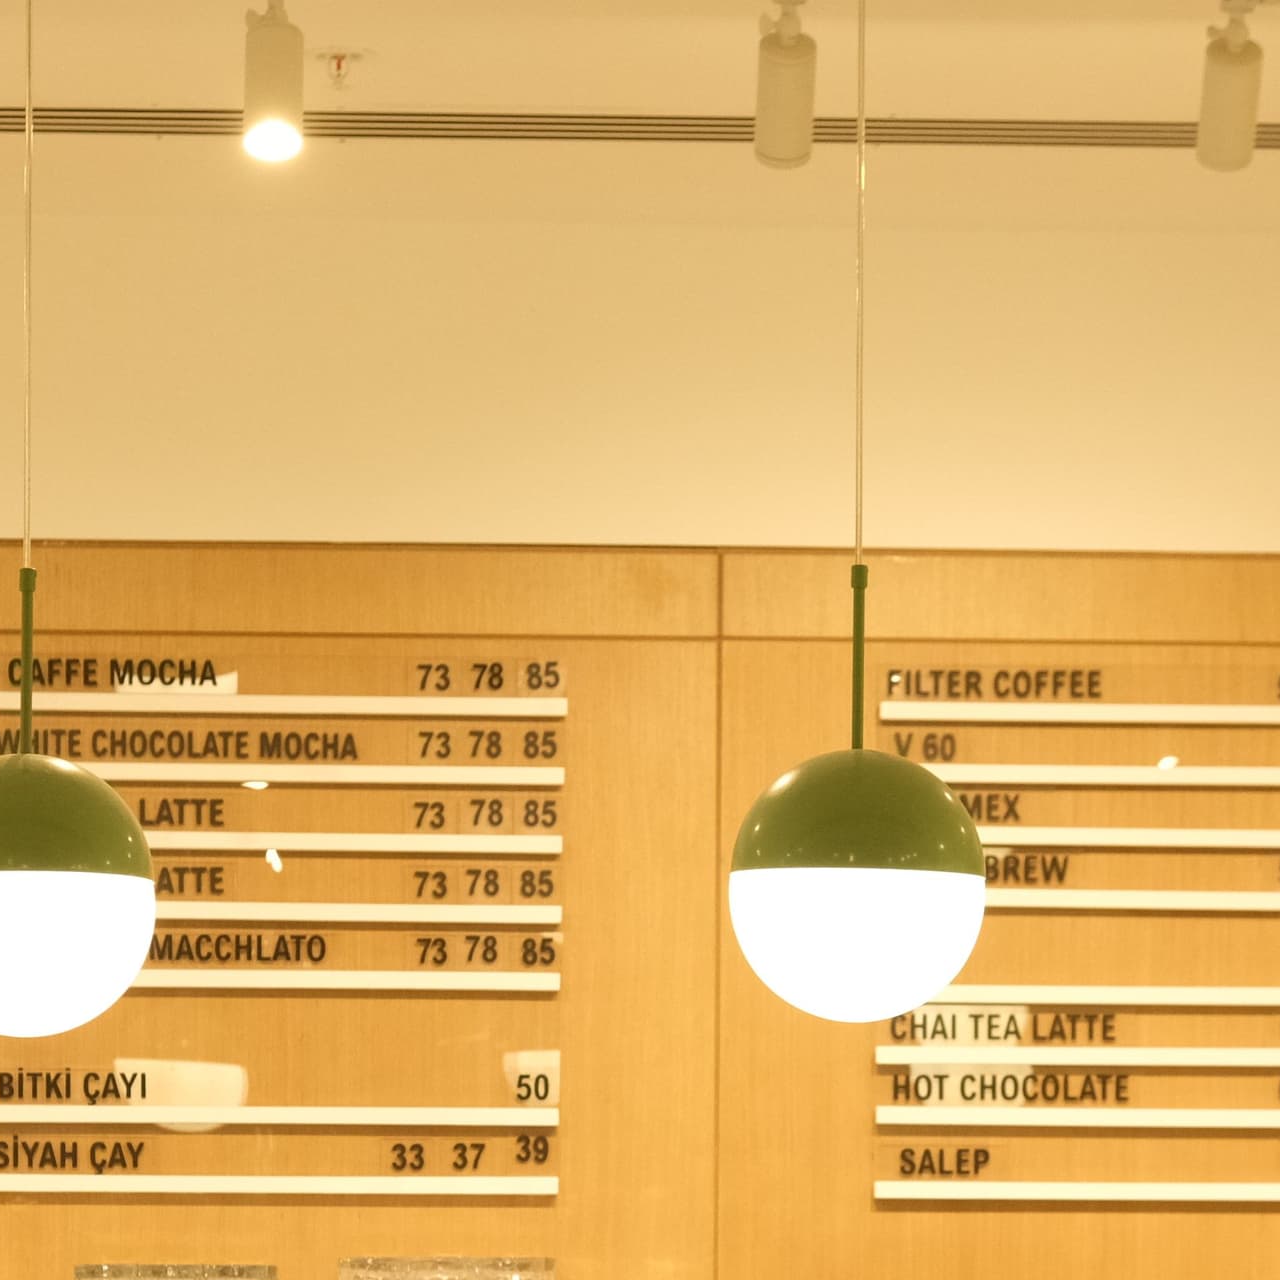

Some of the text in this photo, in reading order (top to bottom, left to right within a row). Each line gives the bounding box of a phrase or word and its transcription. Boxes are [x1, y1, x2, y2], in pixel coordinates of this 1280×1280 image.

[8, 659, 559, 690] CAFFE MOCHA 73 78 85
[888, 671, 982, 697] FILTER
[994, 672, 1101, 697] COFFEE
[91, 730, 249, 759] CHOCOLATE
[259, 732, 358, 760] MOCHA
[418, 732, 451, 758] 73
[469, 731, 502, 757] 78
[523, 731, 557, 757] 85
[895, 733, 913, 757] V
[923, 733, 956, 761] 60
[140, 799, 557, 829] LATTE 73 78 85
[960, 795, 1020, 821] MEX
[156, 867, 554, 898] ATTE 73 78 85
[985, 856, 1068, 883] BREW
[149, 935, 555, 965] MACCHLATO 73 78 85
[891, 1014, 957, 1040] CHAI
[970, 1014, 1021, 1040] TEA
[1032, 1015, 1115, 1040] LATTE
[83, 1073, 146, 1105] ÇAYI
[516, 1074, 549, 1100] 50
[893, 1075, 948, 1101] HOT
[960, 1074, 1128, 1102] CHOCOLATE
[90, 1143, 144, 1175] ÇAY
[392, 1144, 425, 1170] 33
[452, 1143, 485, 1170] 37
[516, 1137, 550, 1163] 39
[900, 1149, 989, 1175] SALEP
